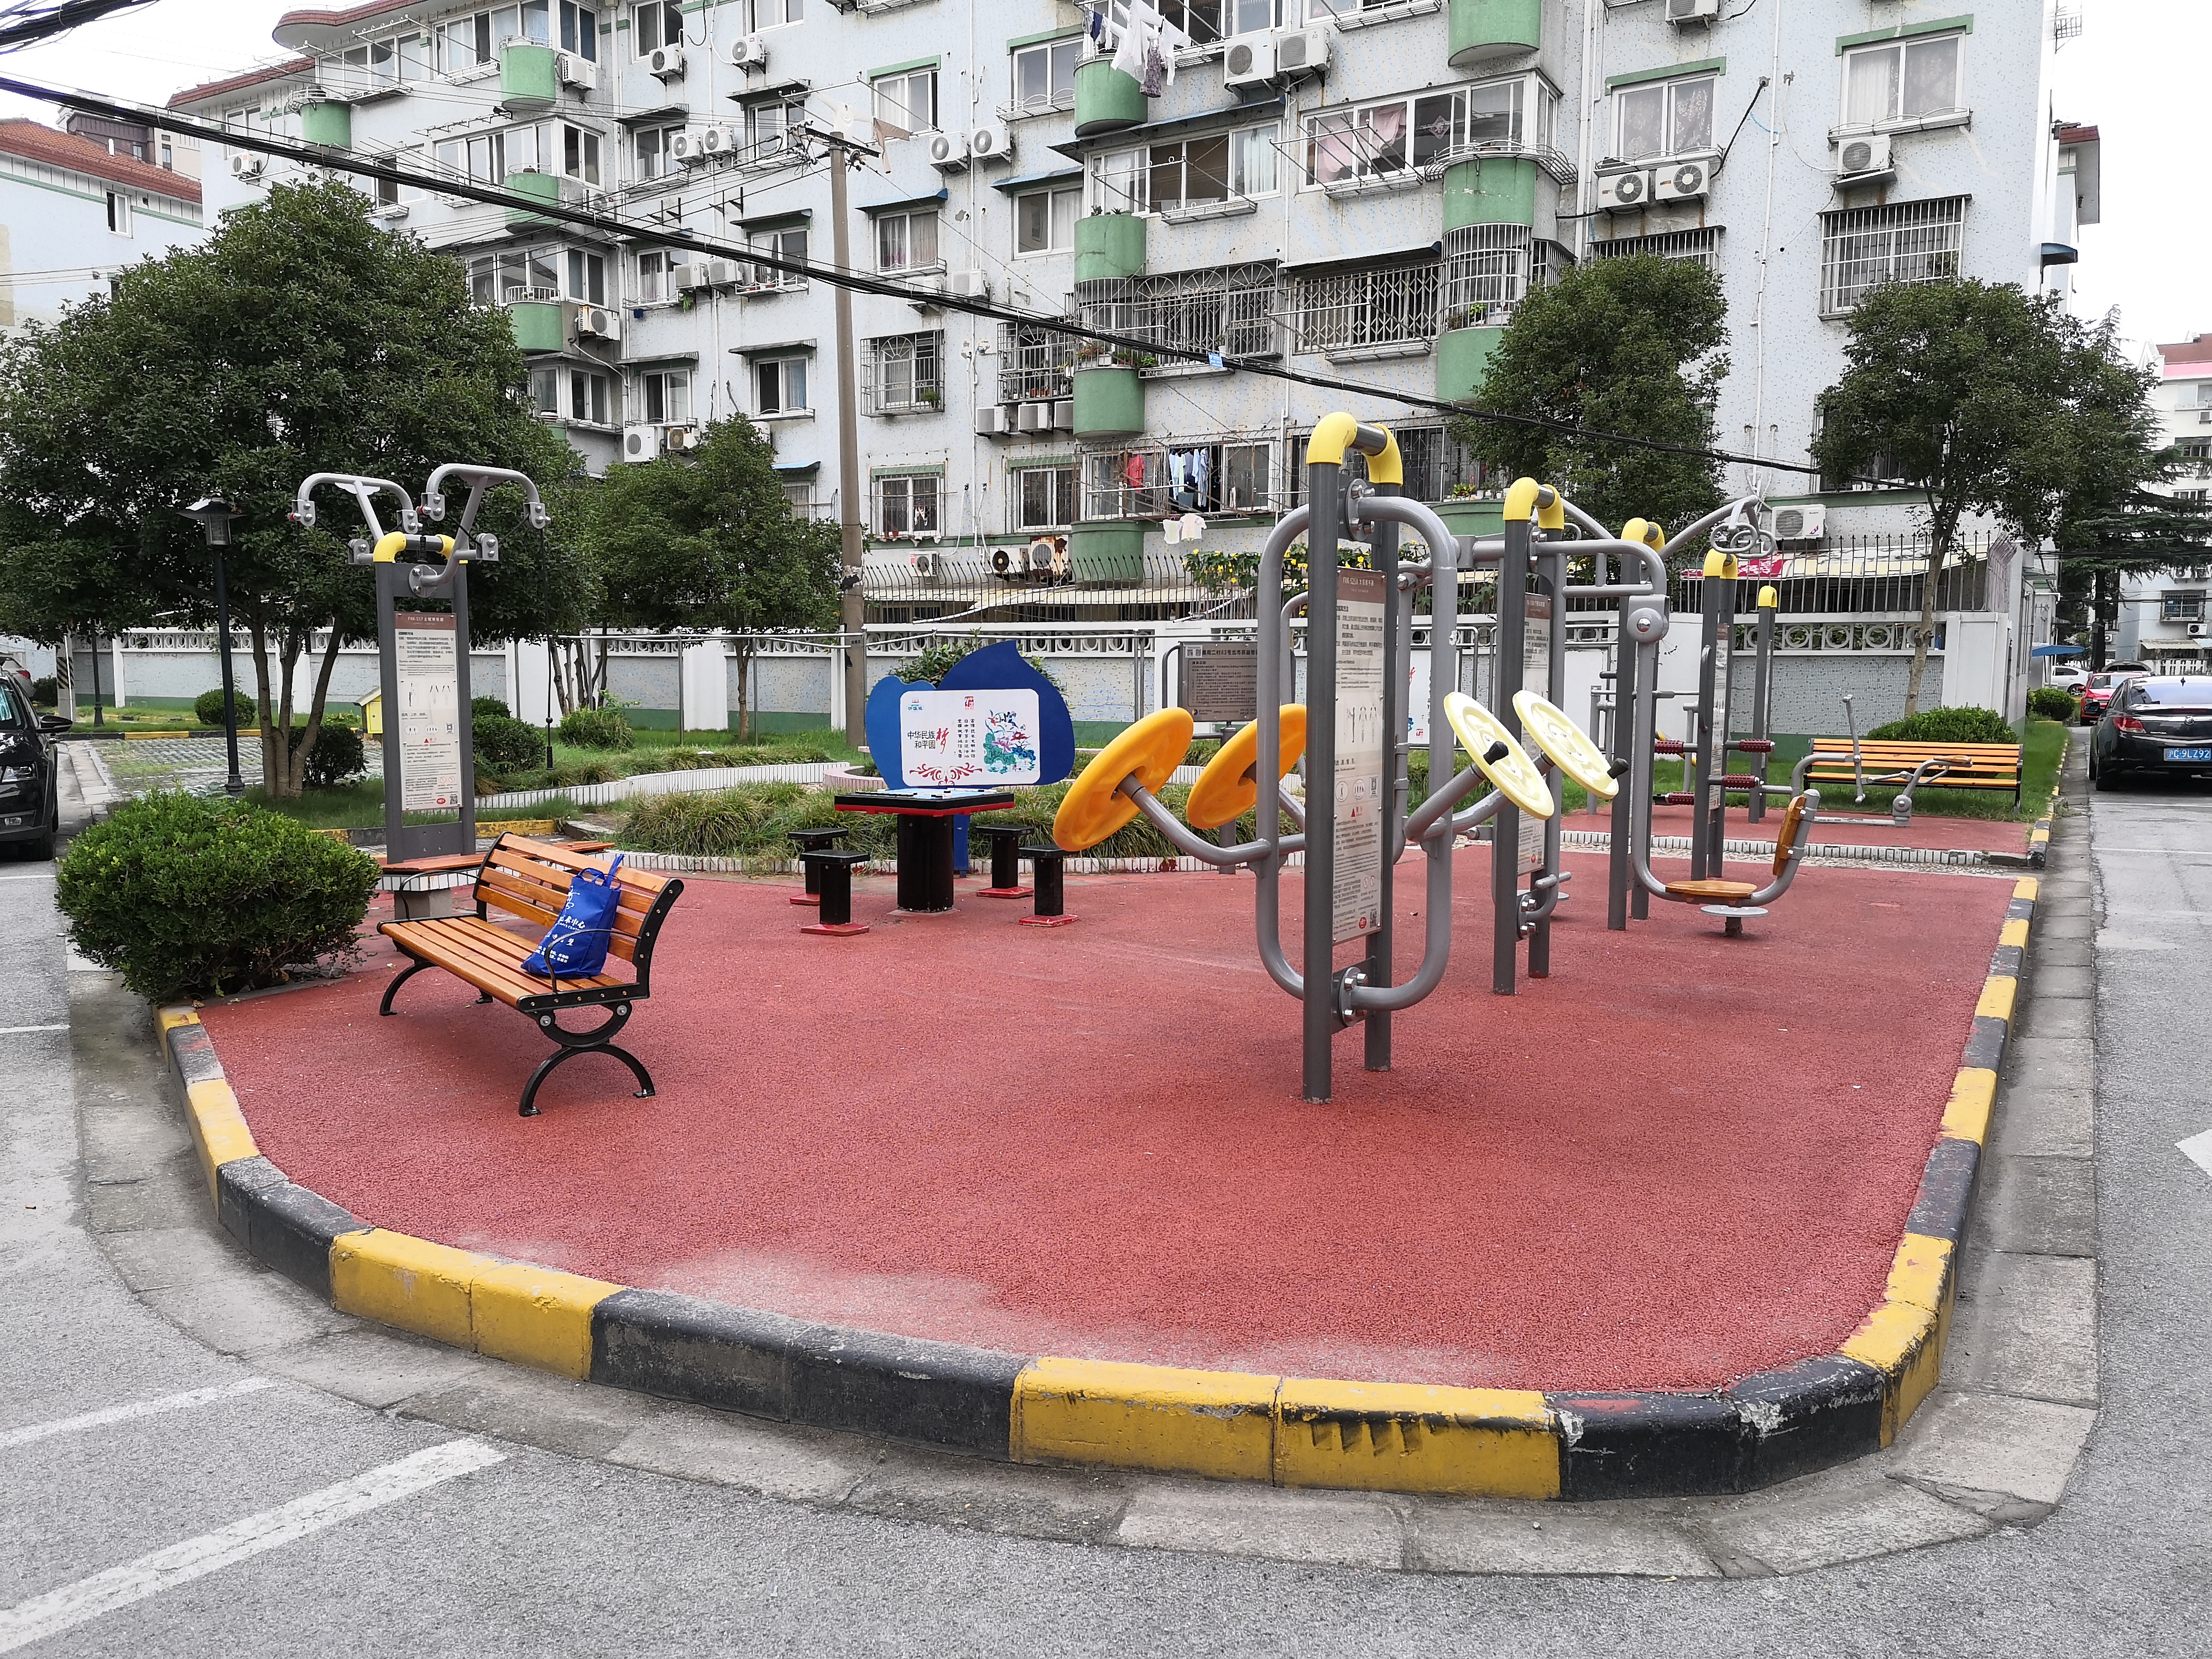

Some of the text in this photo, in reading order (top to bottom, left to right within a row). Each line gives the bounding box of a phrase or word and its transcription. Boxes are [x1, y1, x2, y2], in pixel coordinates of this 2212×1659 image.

[907, 731, 935, 740] 中华民族
[915, 740, 936, 749] 和平圆
[936, 727, 949, 754] 梦
